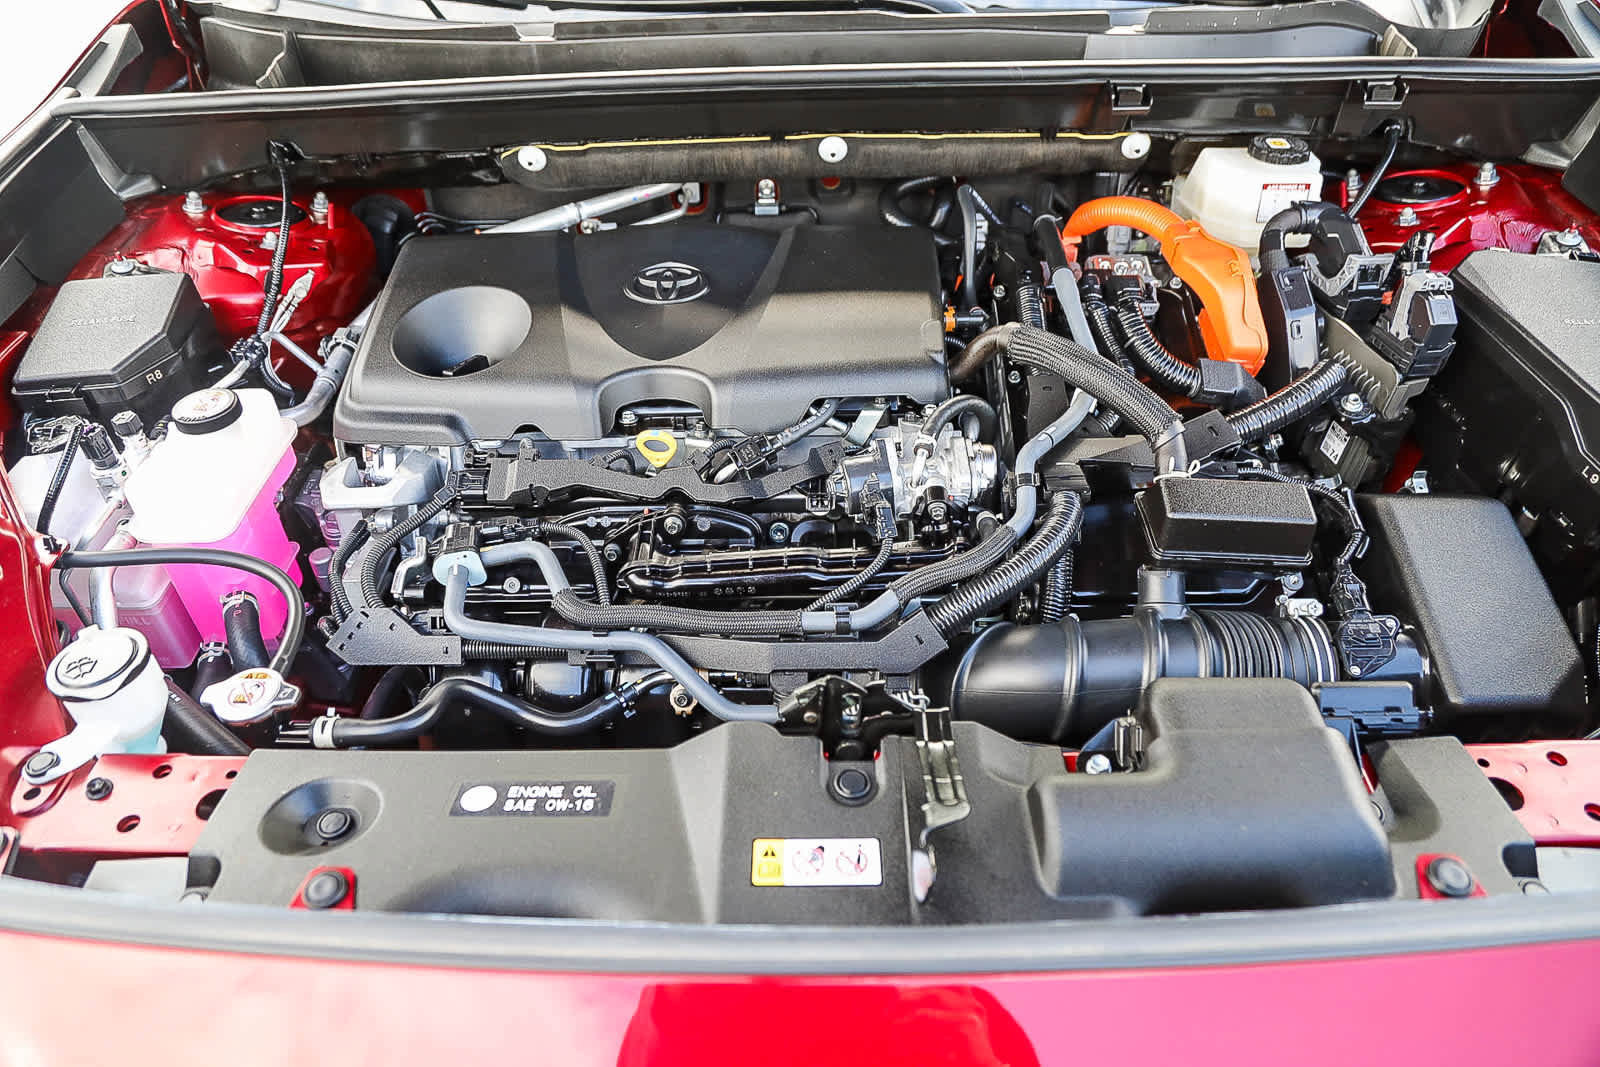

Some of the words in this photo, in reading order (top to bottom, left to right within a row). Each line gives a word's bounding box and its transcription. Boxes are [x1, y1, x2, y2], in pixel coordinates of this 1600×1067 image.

[145, 369, 163, 385] R8
[1581, 465, 1599, 484] L9
[507, 785, 565, 798] ENGINE
[573, 785, 597, 798] OIL
[503, 799, 537, 812] SAE
[544, 799, 594, 812] 0W-16
